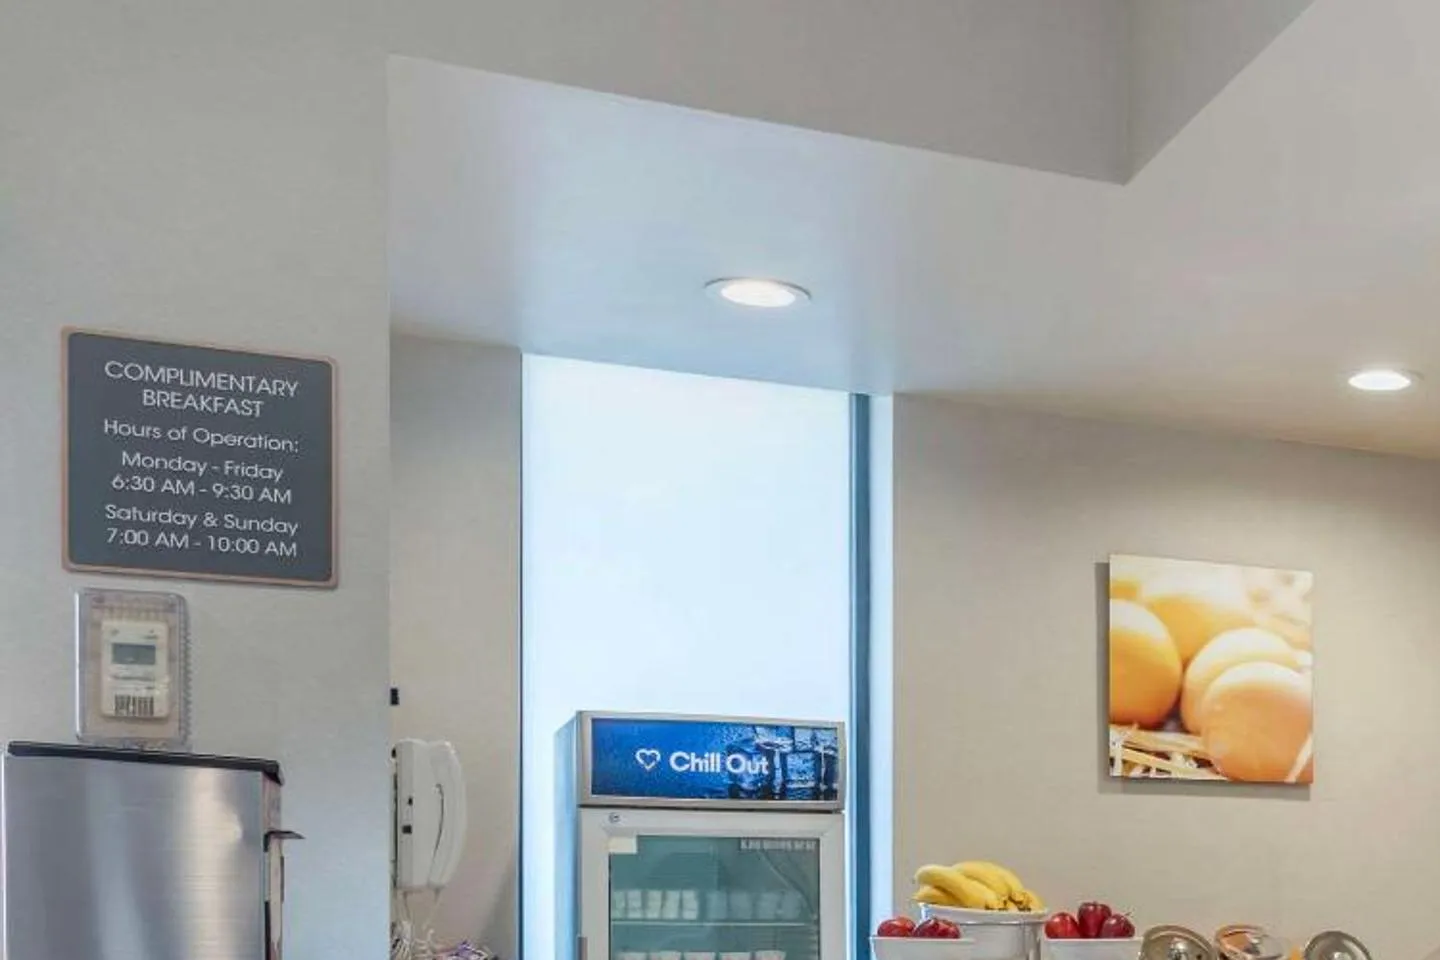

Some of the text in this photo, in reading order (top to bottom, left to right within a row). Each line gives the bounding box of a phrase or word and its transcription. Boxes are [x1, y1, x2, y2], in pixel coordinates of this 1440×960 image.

[104, 360, 299, 397] COMPLIMENTARY
[142, 389, 264, 418] BREAKFAST
[104, 418, 299, 453] Hours of Operation:
[121, 451, 208, 476] Monday
[224, 460, 284, 482] Friday
[111, 476, 155, 493] 6:30
[161, 479, 195, 496] AM
[212, 483, 254, 500] 9:30
[259, 488, 292, 504] AM
[105, 504, 299, 536] Saturday & Sunday
[107, 528, 149, 545] 7:00
[155, 531, 189, 548] AM
[208, 535, 260, 554] 10:00
[265, 541, 297, 557] AM
[669, 751, 769, 774] Chill Out
